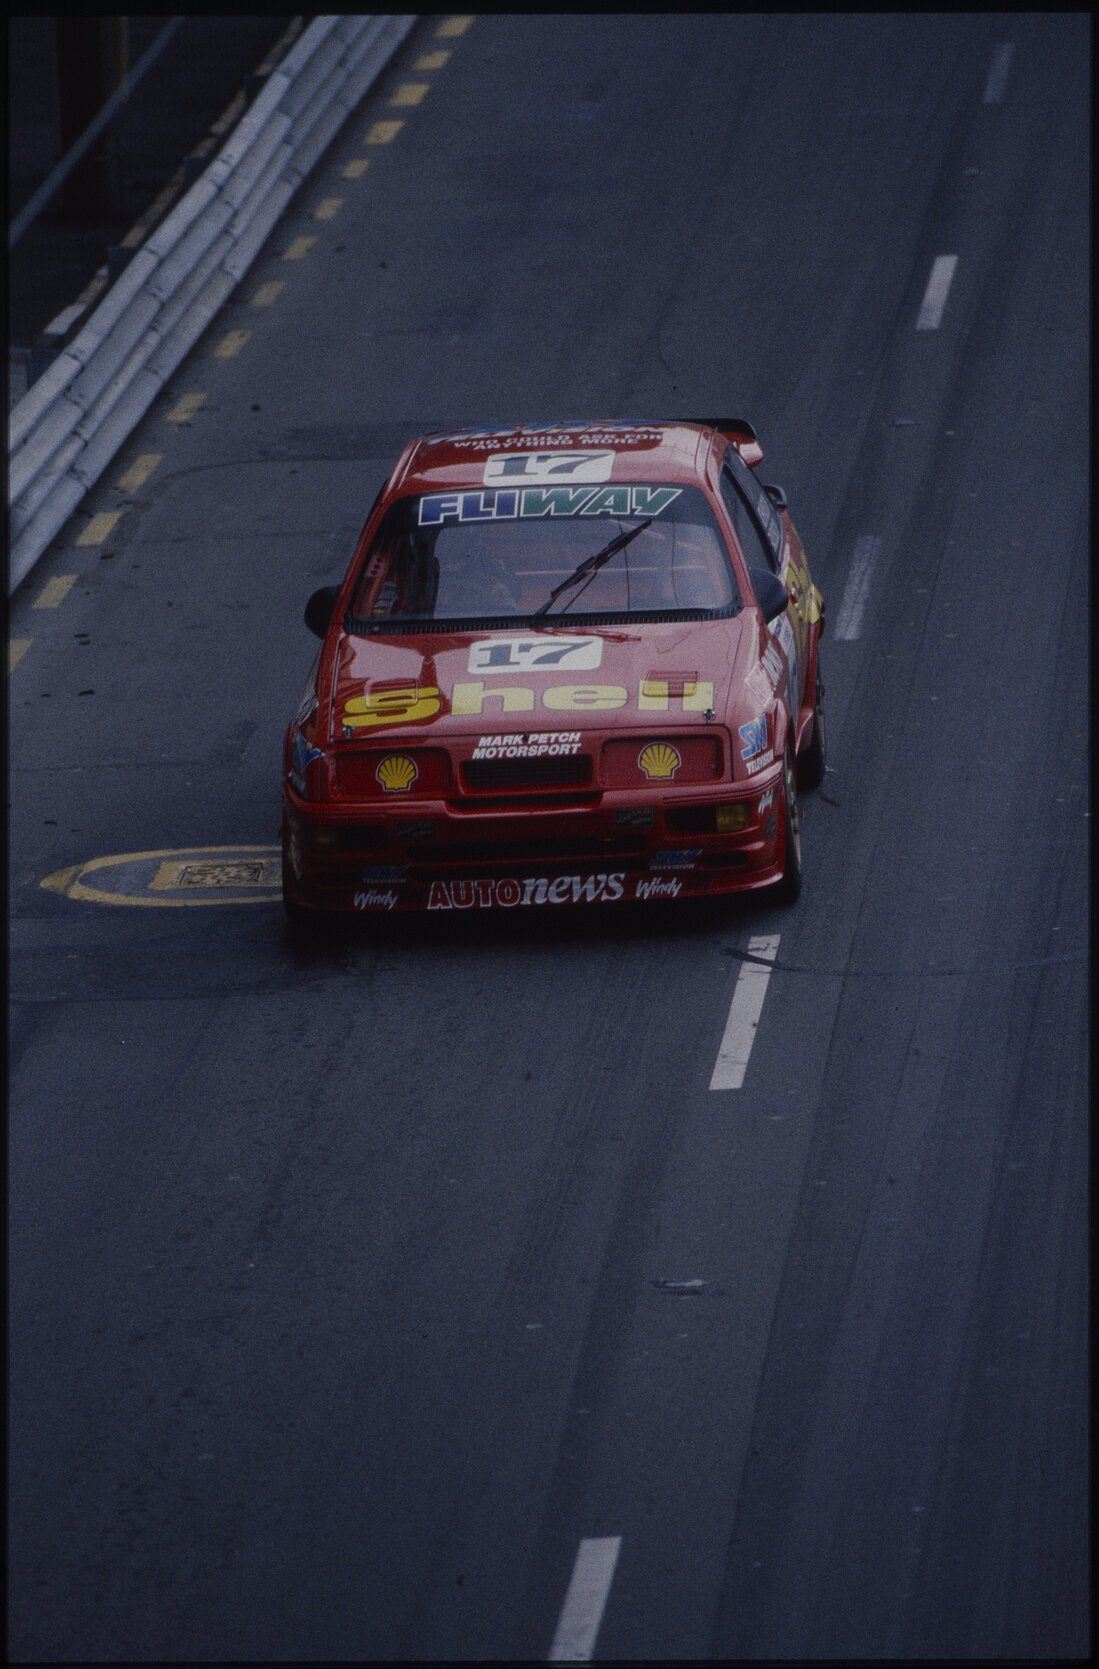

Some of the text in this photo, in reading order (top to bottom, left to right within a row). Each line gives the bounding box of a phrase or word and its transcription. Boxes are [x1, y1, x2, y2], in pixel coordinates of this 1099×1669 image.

[473, 439, 574, 451] ANYTHING
[488, 453, 613, 477] 17
[418, 487, 683, 526] FLIWAY
[477, 640, 596, 668] 17
[342, 679, 714, 726] Shell
[472, 743, 582, 760] MOTORSPORT
[478, 732, 582, 748] MARK PETCH
[353, 888, 399, 911] Windy
[635, 876, 683, 900] Windy
